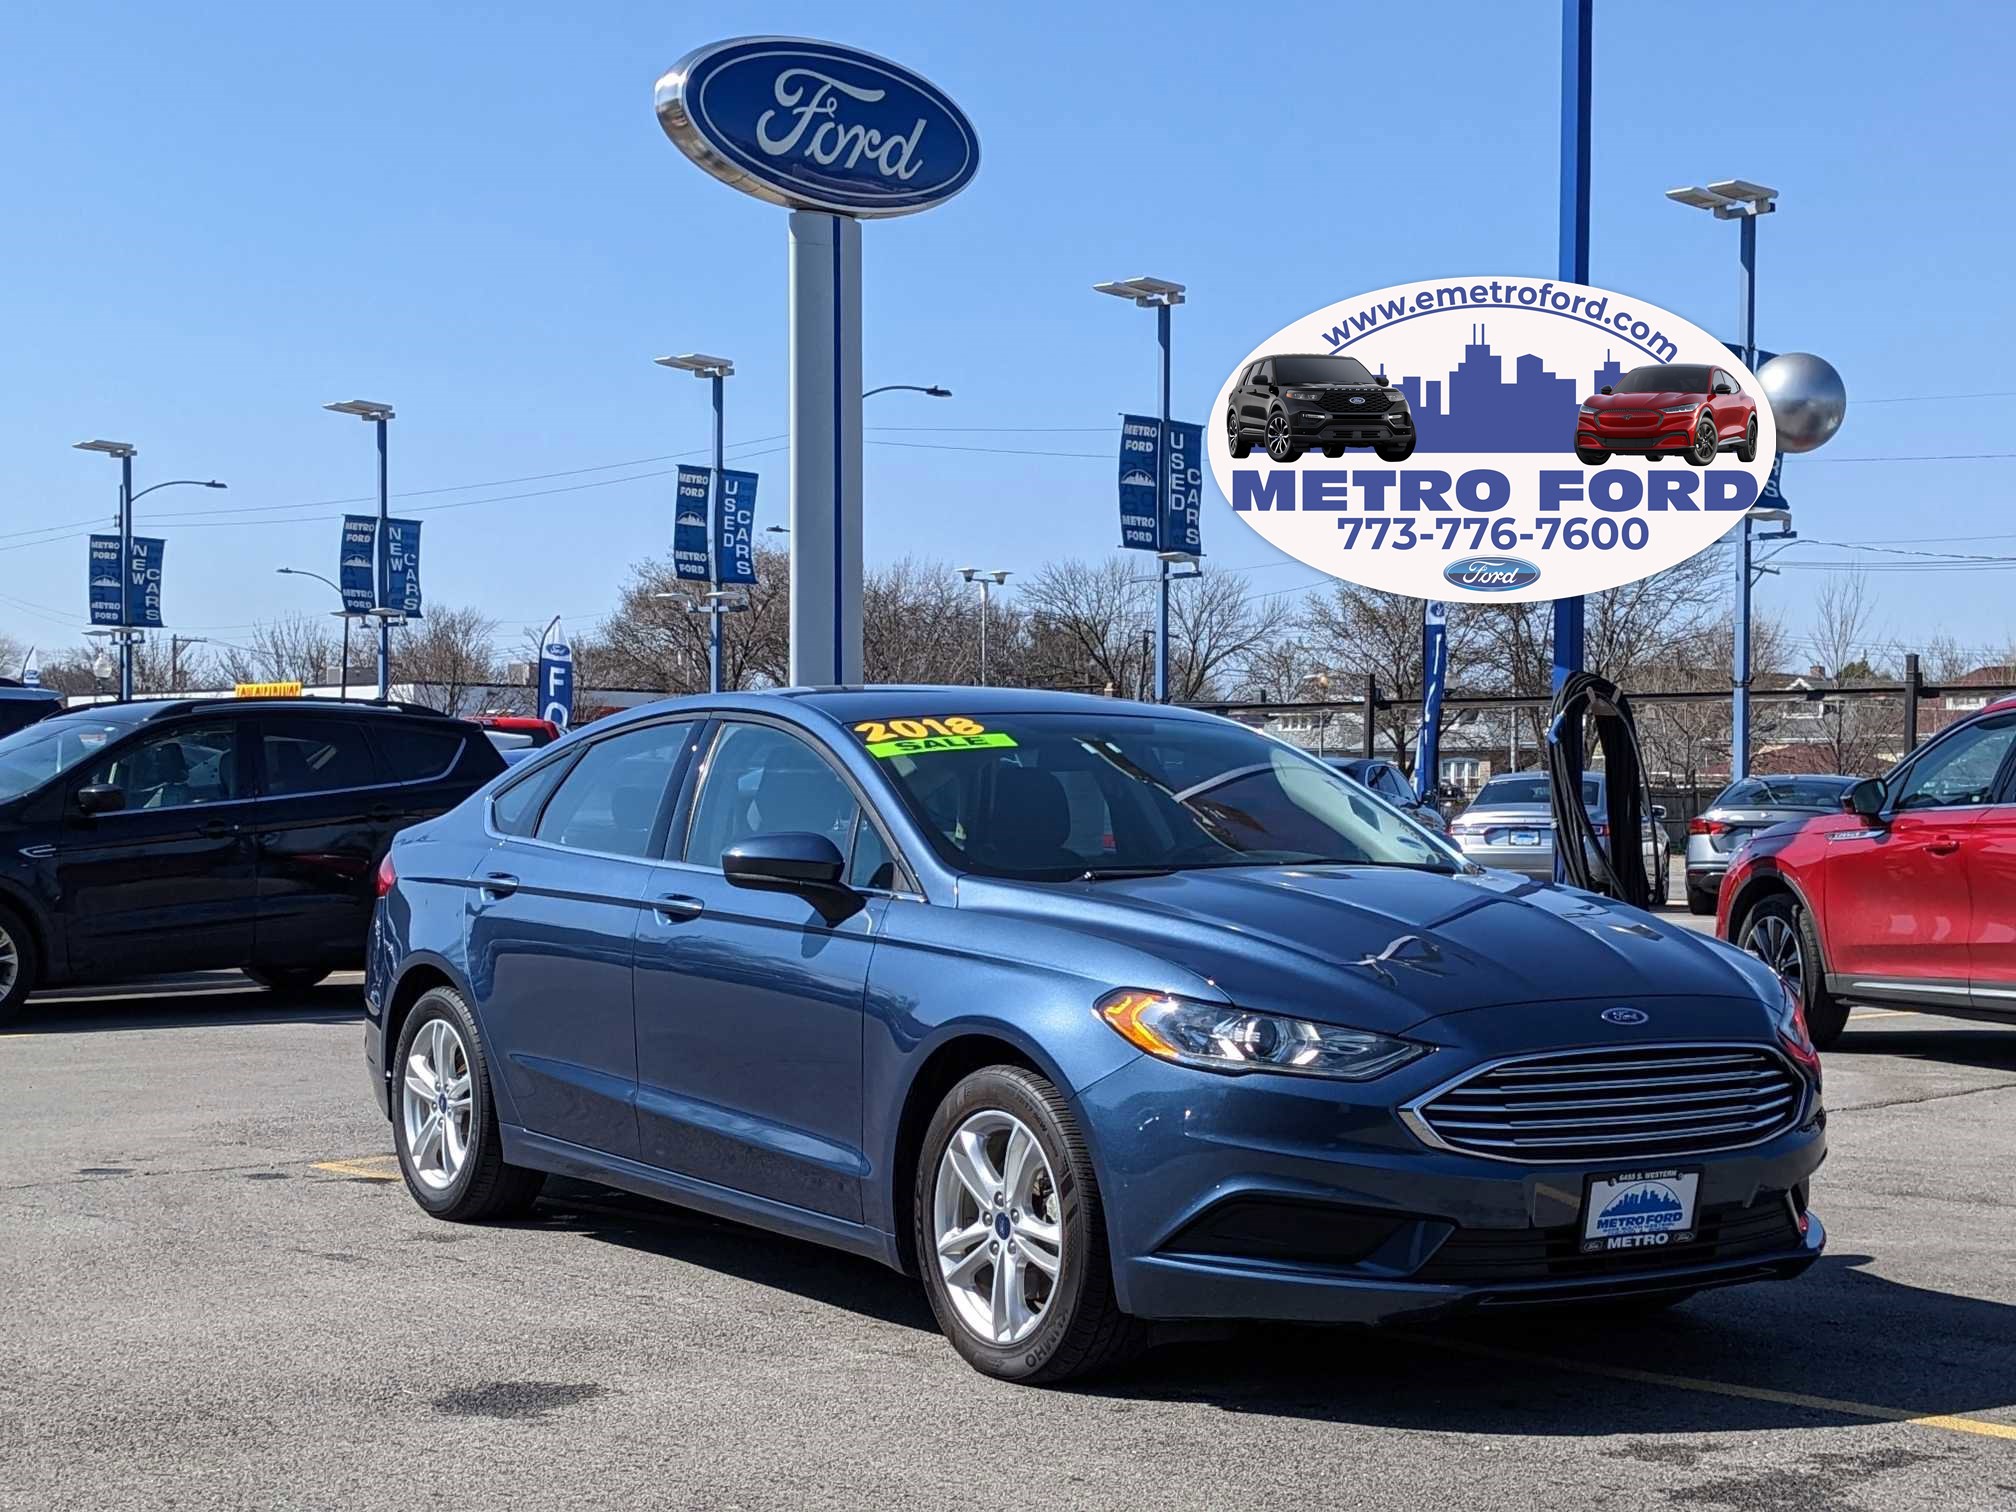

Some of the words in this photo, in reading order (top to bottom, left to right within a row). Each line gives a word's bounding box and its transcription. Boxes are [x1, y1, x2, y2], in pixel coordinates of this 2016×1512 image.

[756, 68, 927, 180] Ford
[1124, 424, 1157, 438] METRO
[1125, 440, 1153, 452] FORD
[679, 473, 708, 485] METRO
[680, 487, 704, 497] FORD
[1170, 432, 1185, 511] USED
[1186, 468, 1200, 545] CARS
[345, 522, 375, 532] METRO
[724, 480, 738, 547] USED
[736, 510, 751, 575] CARS
[1122, 515, 1155, 528] METRO
[347, 534, 371, 543] FORD
[1127, 531, 1152, 542] FORD
[91, 541, 120, 549] METRO
[675, 550, 707, 562] METRO
[389, 527, 403, 571] NEW
[403, 553, 418, 610] CARS
[680, 564, 705, 574] FORD
[132, 545, 147, 585] NEW
[145, 569, 160, 621] CARS
[342, 588, 373, 599] METRO
[92, 602, 120, 610] METRO
[347, 600, 372, 609] FORD
[95, 612, 119, 620] FORD
[854, 716, 985, 743] 2018
[894, 736, 988, 751] SALE
[1597, 1215, 1645, 1229] METRO
[1645, 1212, 1683, 1224] FORD
[1607, 1233, 1669, 1249] METRO
